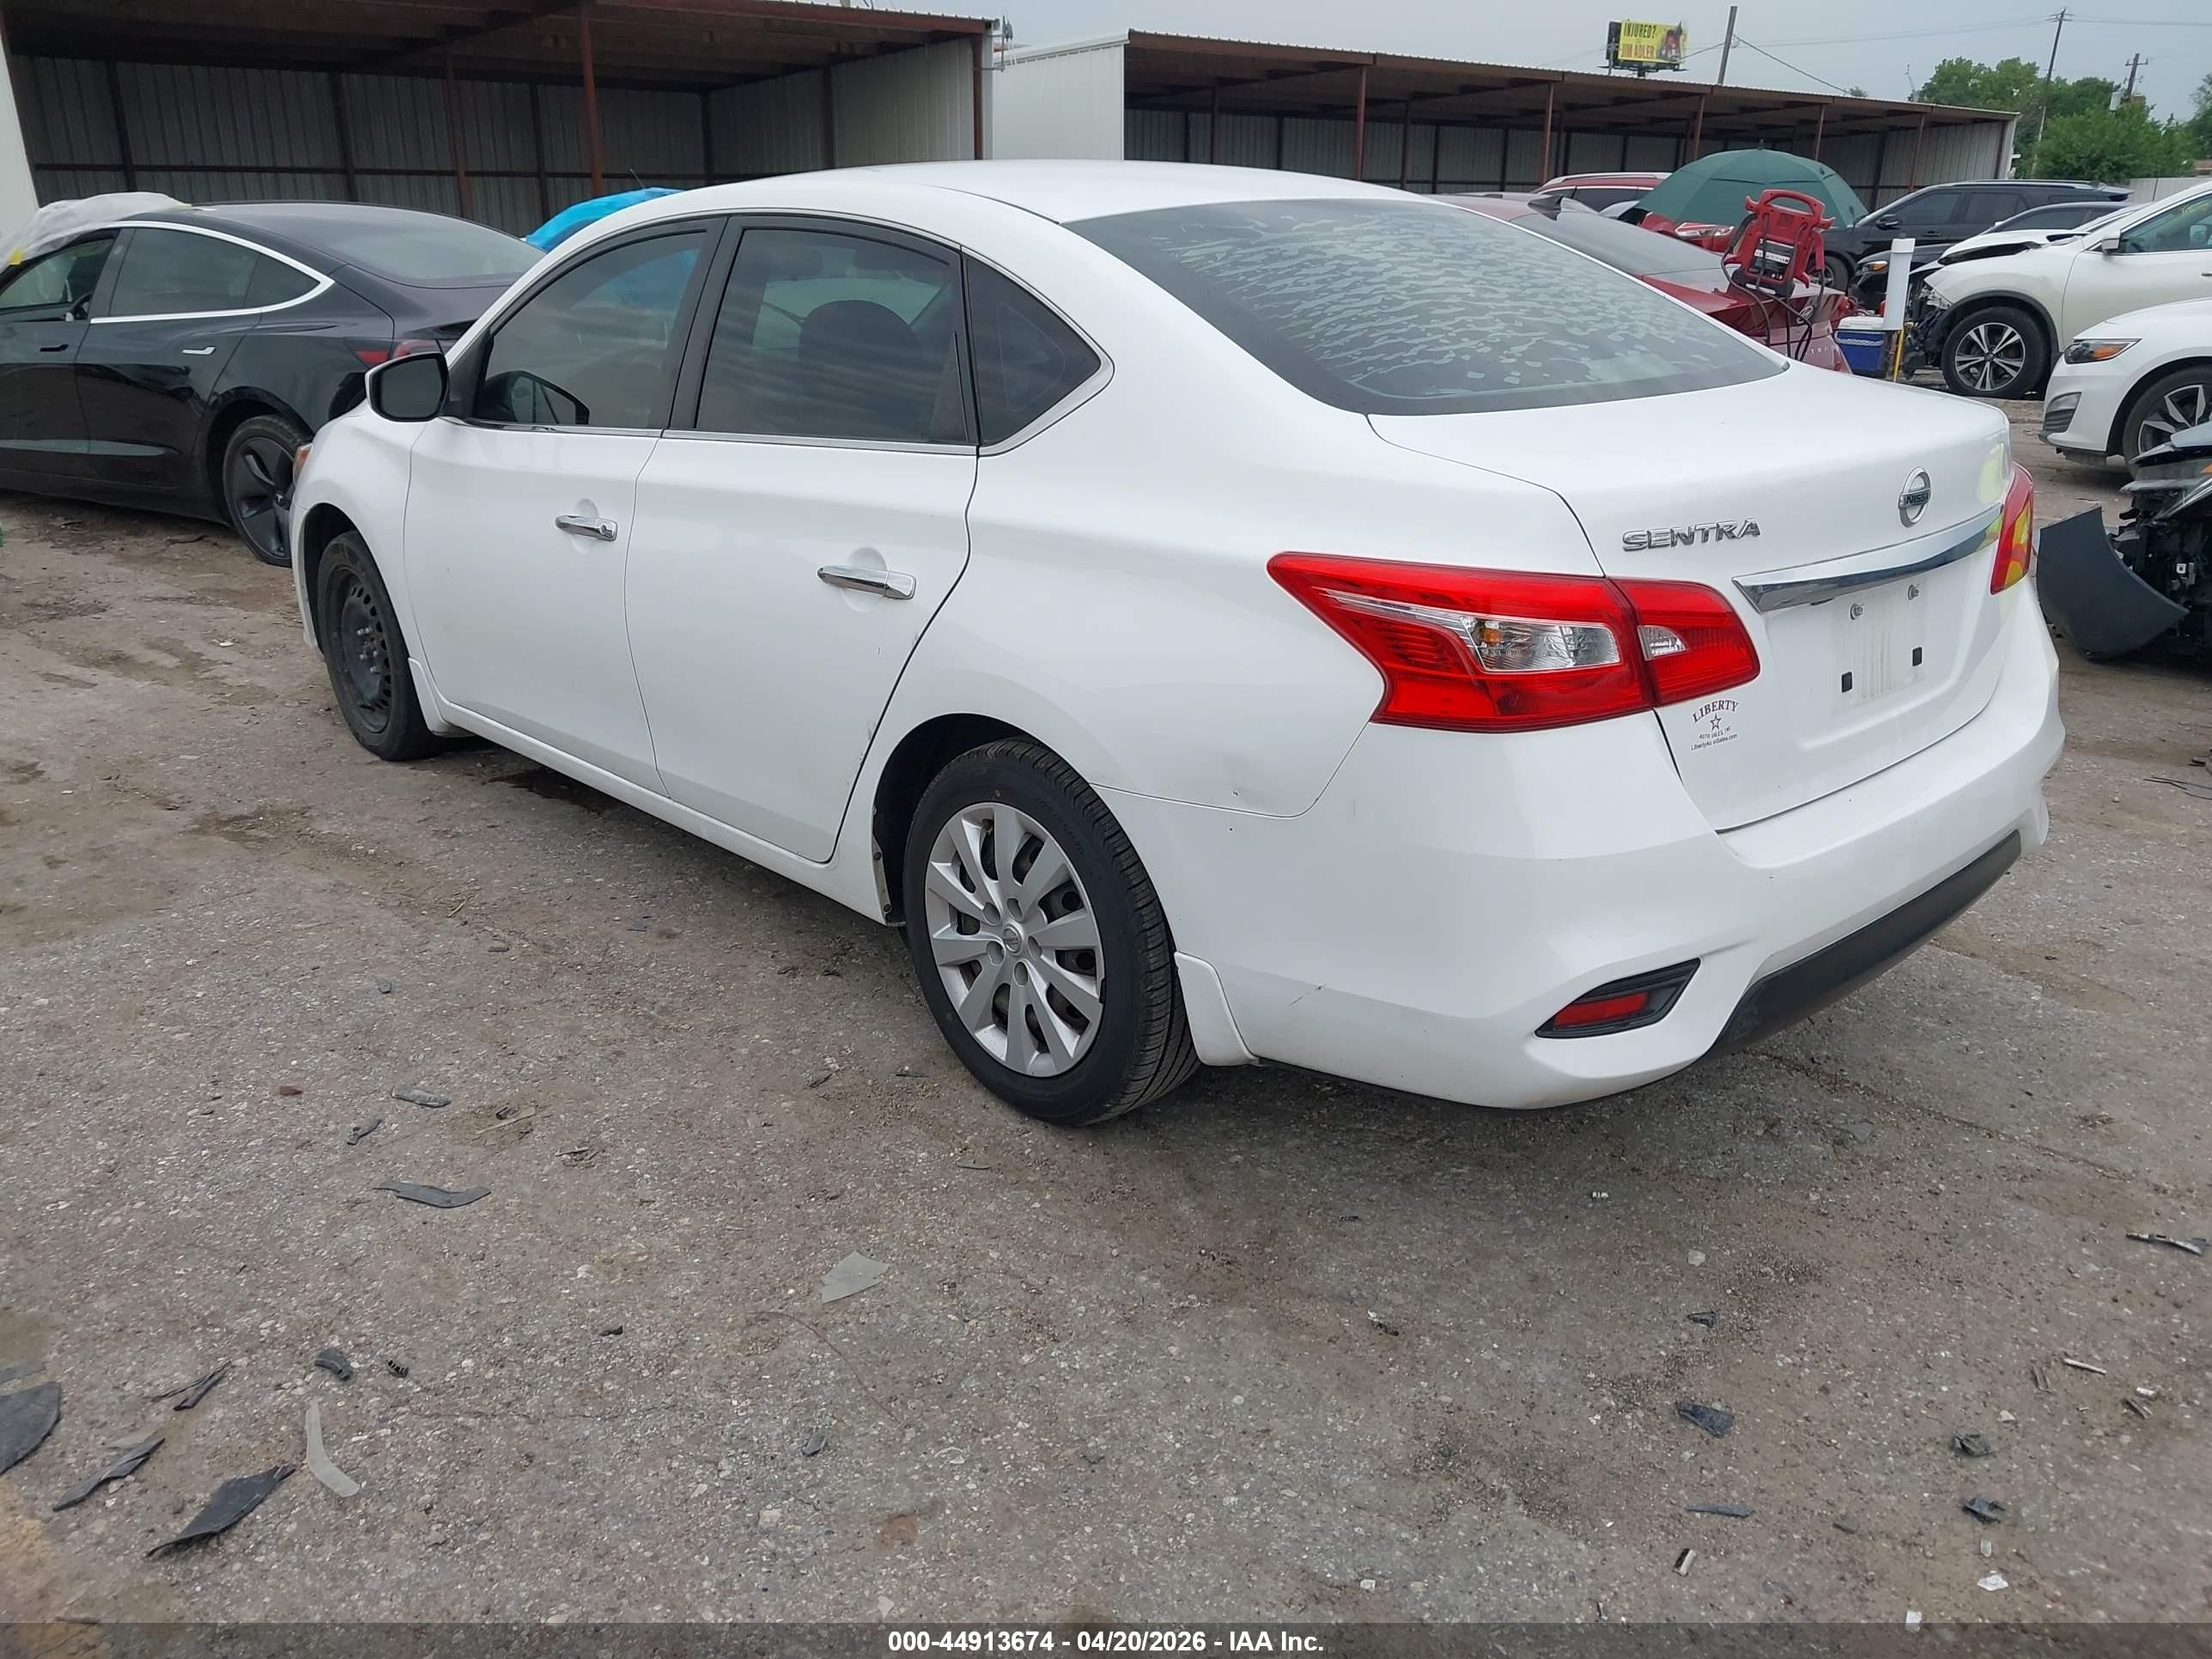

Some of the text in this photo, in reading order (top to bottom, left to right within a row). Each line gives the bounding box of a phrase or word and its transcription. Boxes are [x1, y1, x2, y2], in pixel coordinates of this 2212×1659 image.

[1623, 22, 1657, 39] INJURED?
[1622, 518, 1761, 552] SENTRA
[1692, 700, 1738, 723] LIBERTY
